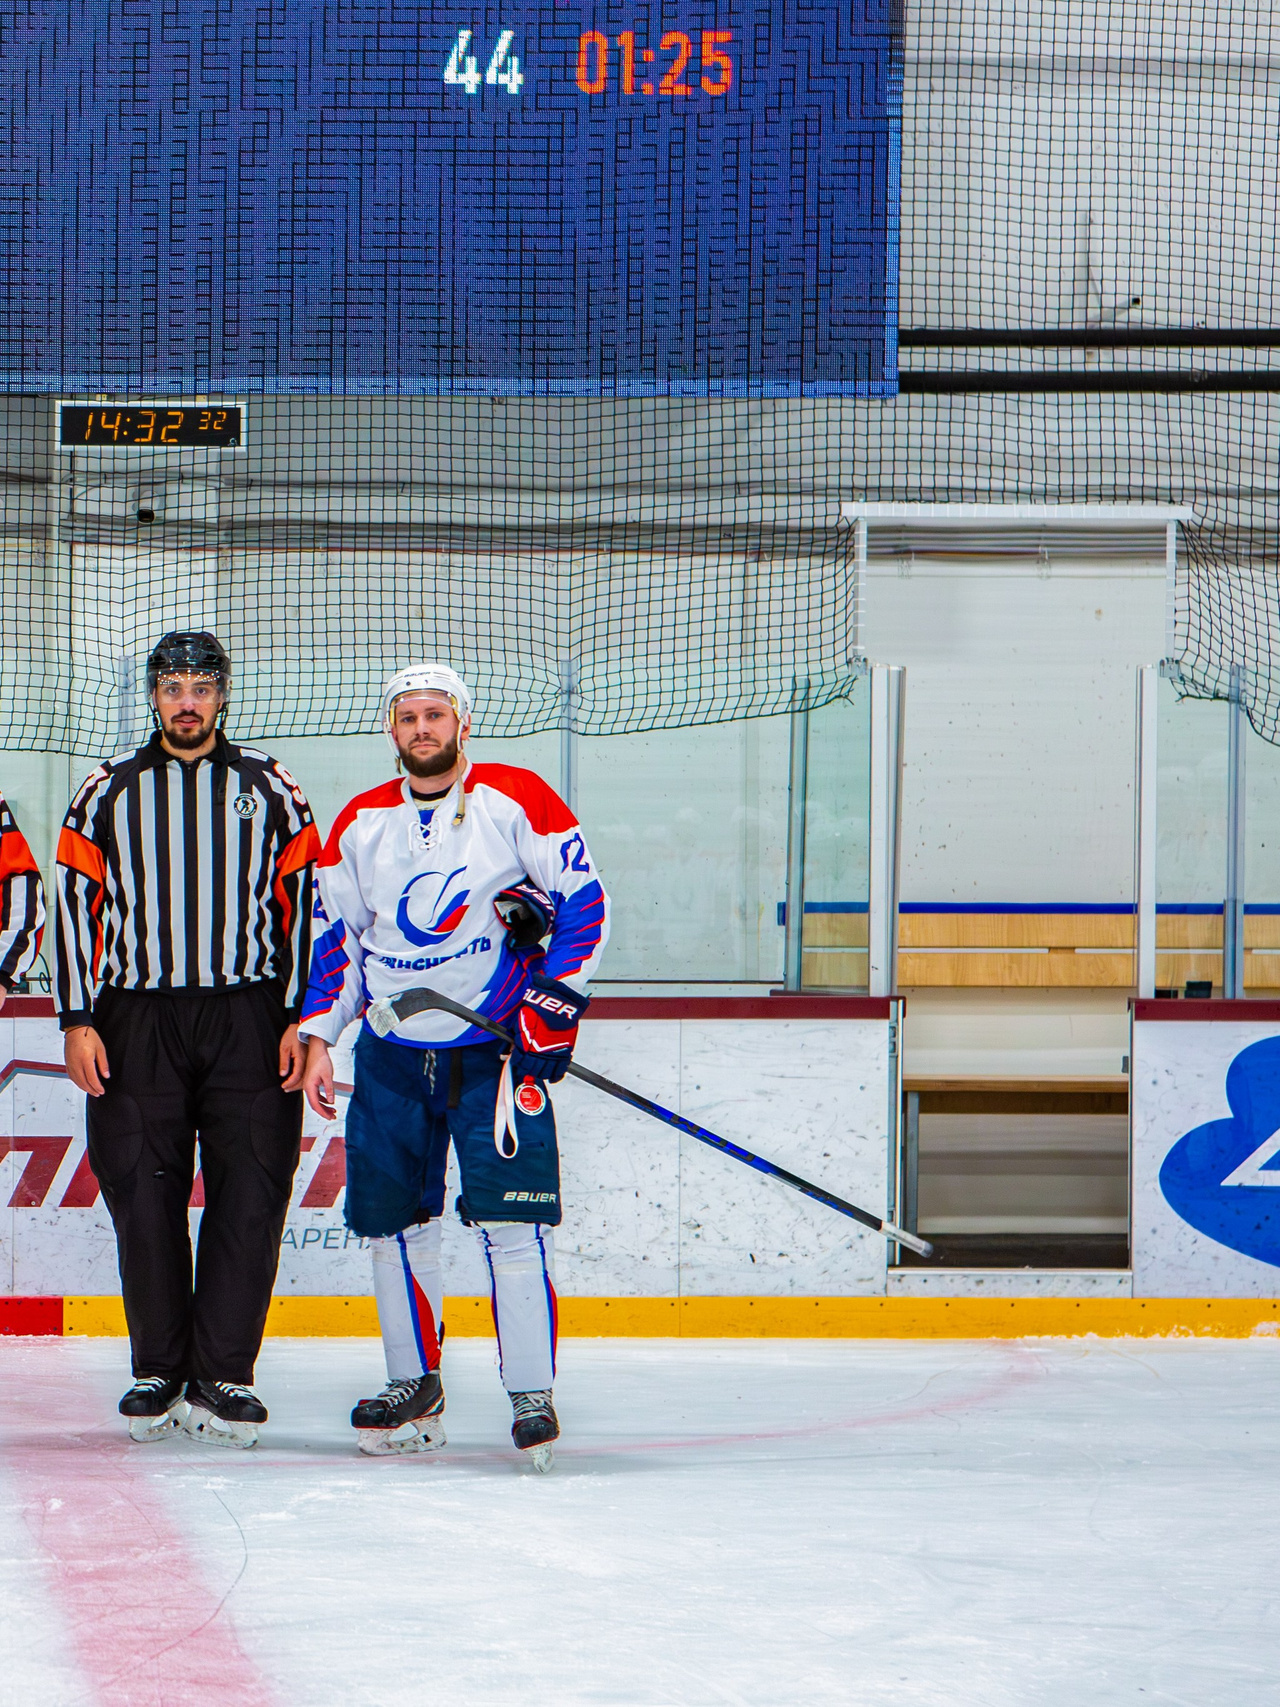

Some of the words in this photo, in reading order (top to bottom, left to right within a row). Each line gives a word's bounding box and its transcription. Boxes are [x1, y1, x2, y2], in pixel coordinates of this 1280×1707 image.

[443, 30, 524, 94] 44
[576, 31, 732, 95] 01:25
[85, 411, 184, 442] 14:32
[198, 411, 227, 430] 32
[503, 1191, 557, 1204] BAUER
[280, 1228, 371, 1250] АРЕН
